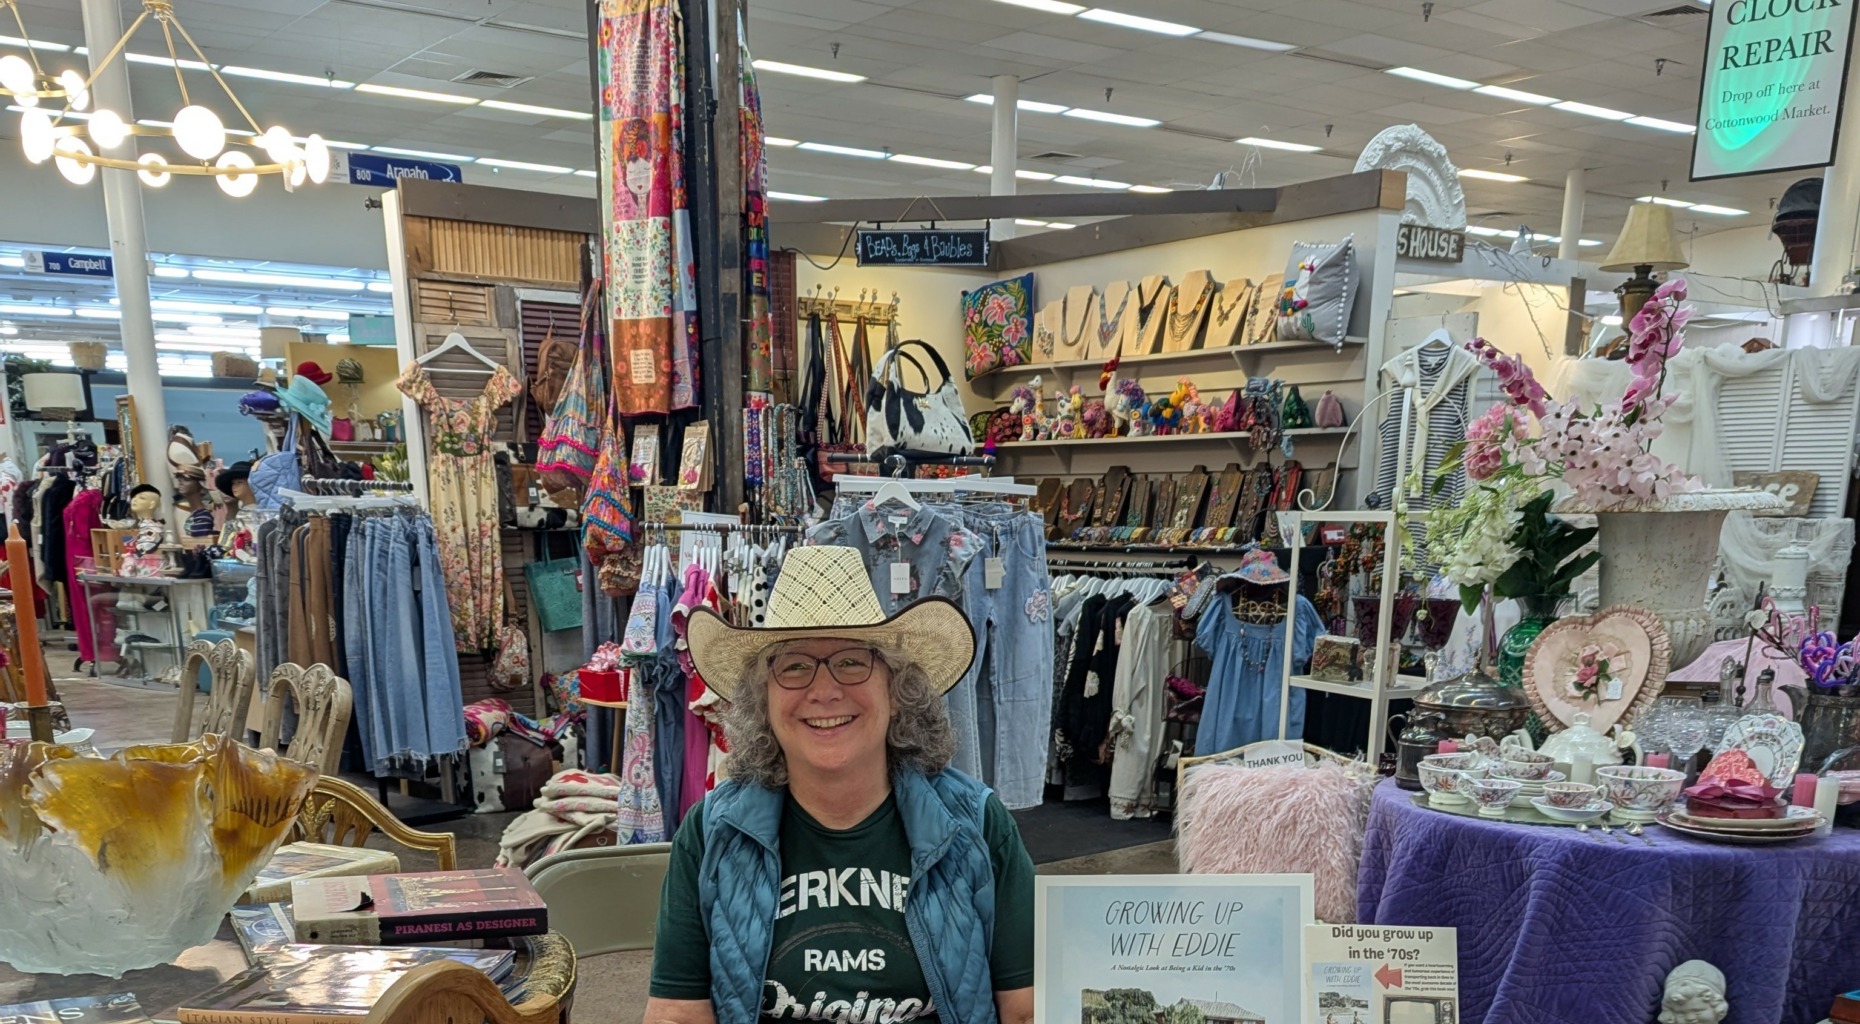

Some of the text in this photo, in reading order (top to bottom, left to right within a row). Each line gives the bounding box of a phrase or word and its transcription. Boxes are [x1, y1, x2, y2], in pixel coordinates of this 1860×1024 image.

[1720, 29, 1835, 70] REPAIR
[1722, 80, 1821, 104] Drop off here at
[1705, 104, 1830, 130] Cottonwood Market.
[356, 170, 372, 181] 800
[931, 235, 973, 260] Baubles
[1408, 227, 1460, 259] HOUSE
[68, 258, 107, 272] Campbell
[1246, 752, 1303, 768] THANK YOU
[1106, 900, 1244, 925] GROWING UP
[394, 918, 537, 934] PIRANESI AS DESIGNER
[1332, 926, 1434, 942] Did you grow up
[1111, 932, 1240, 957] WITH EDDIE
[804, 948, 886, 972] RAMS
[1348, 946, 1420, 960] in the '70s?
[1118, 964, 1144, 972] Nostalgic
[1168, 965, 1186, 973] Being
[1324, 966, 1362, 974] GROWING UP
[1326, 975, 1361, 983] WITH EDDIE
[186, 1014, 244, 1024] ITALIAN
